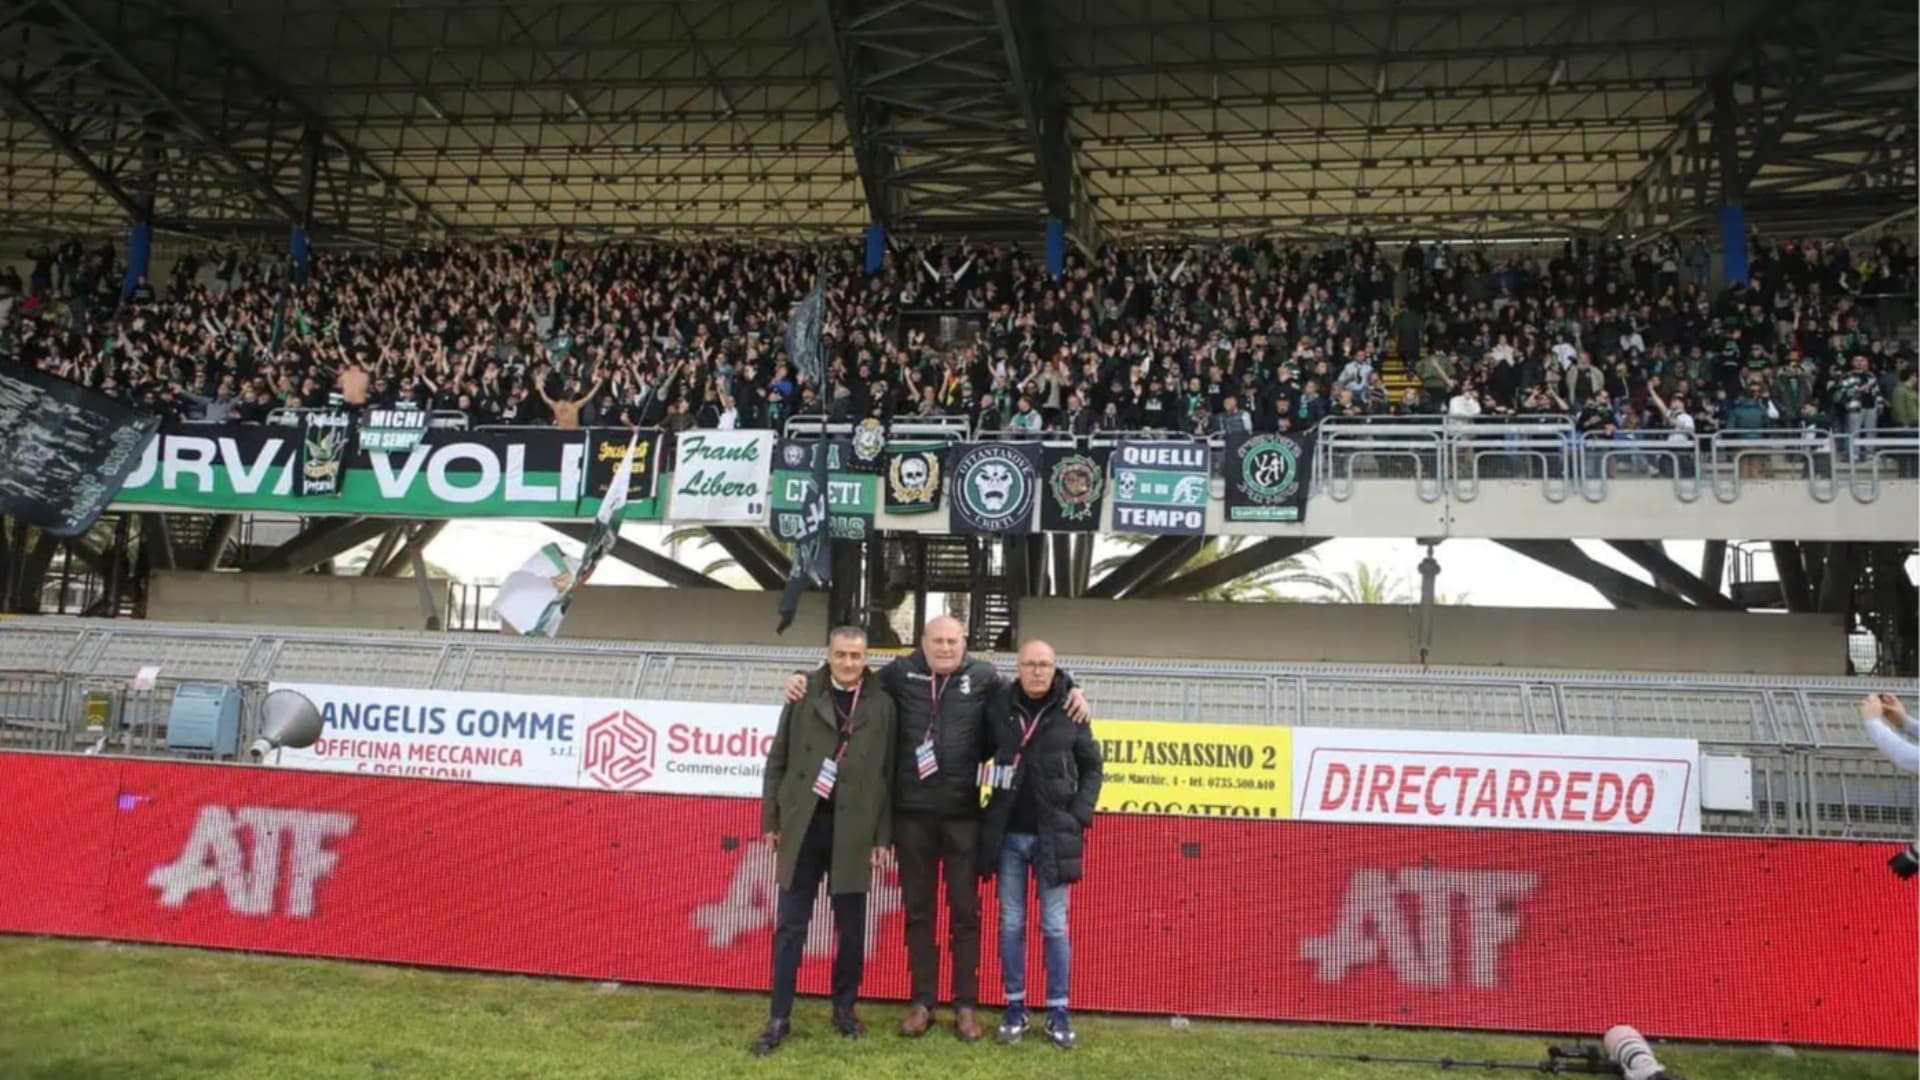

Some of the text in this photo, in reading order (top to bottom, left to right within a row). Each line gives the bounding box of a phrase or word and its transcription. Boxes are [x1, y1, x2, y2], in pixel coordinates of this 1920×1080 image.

[370, 411, 425, 428] MICHI
[681, 435, 759, 465] Frank
[1123, 446, 1203, 466] QUELLI
[678, 470, 759, 498] Libero
[974, 514, 1015, 530] CHIETI
[1118, 507, 1201, 529] TEMPO
[322, 701, 575, 741] ANGELIS GOMME
[314, 738, 523, 768] OFFICINA MECCANICA
[1101, 738, 1276, 770] ELL'ASSASSINO 2
[1319, 762, 1655, 825] DIRECTARREDO
[146, 804, 358, 919] ATF
[1298, 867, 1538, 988] ATF
